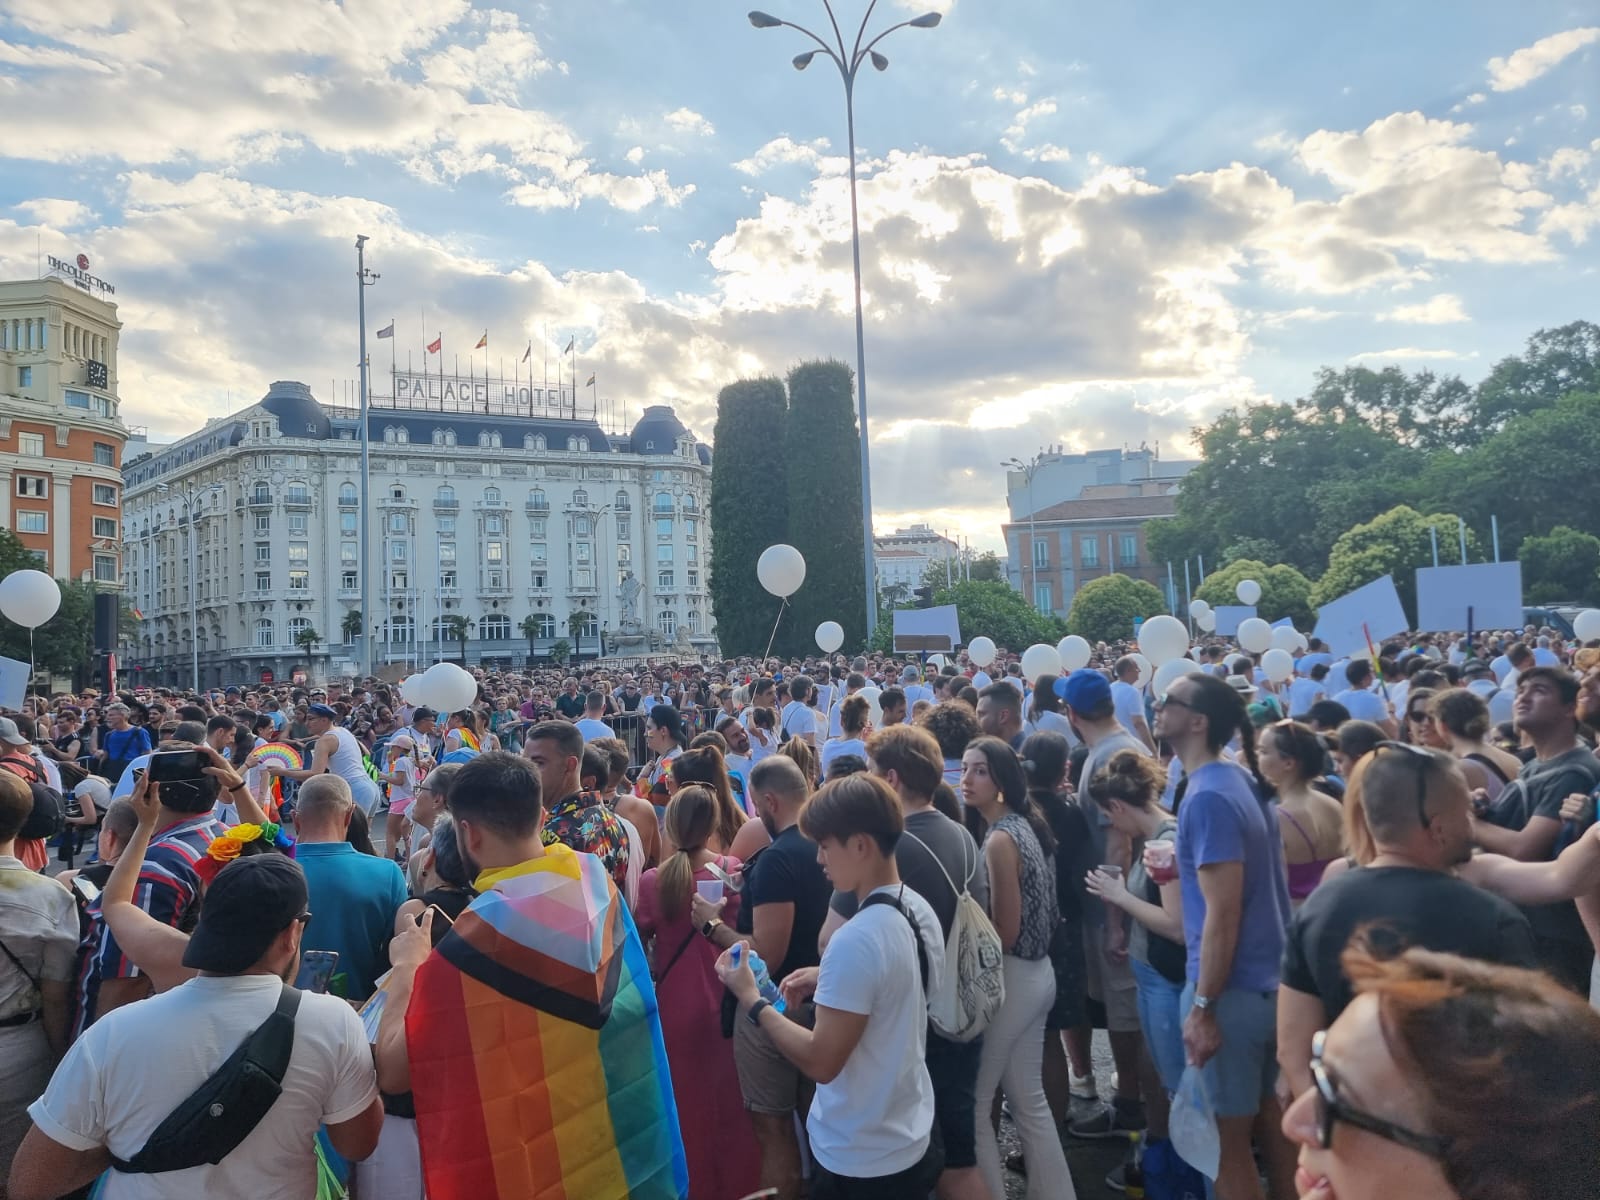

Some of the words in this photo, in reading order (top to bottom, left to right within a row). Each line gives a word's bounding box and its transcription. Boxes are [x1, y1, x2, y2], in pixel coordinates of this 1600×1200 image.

[61, 262, 115, 295] COLLECTION
[397, 378, 487, 403] PALACE
[505, 386, 574, 409] HOTEL
